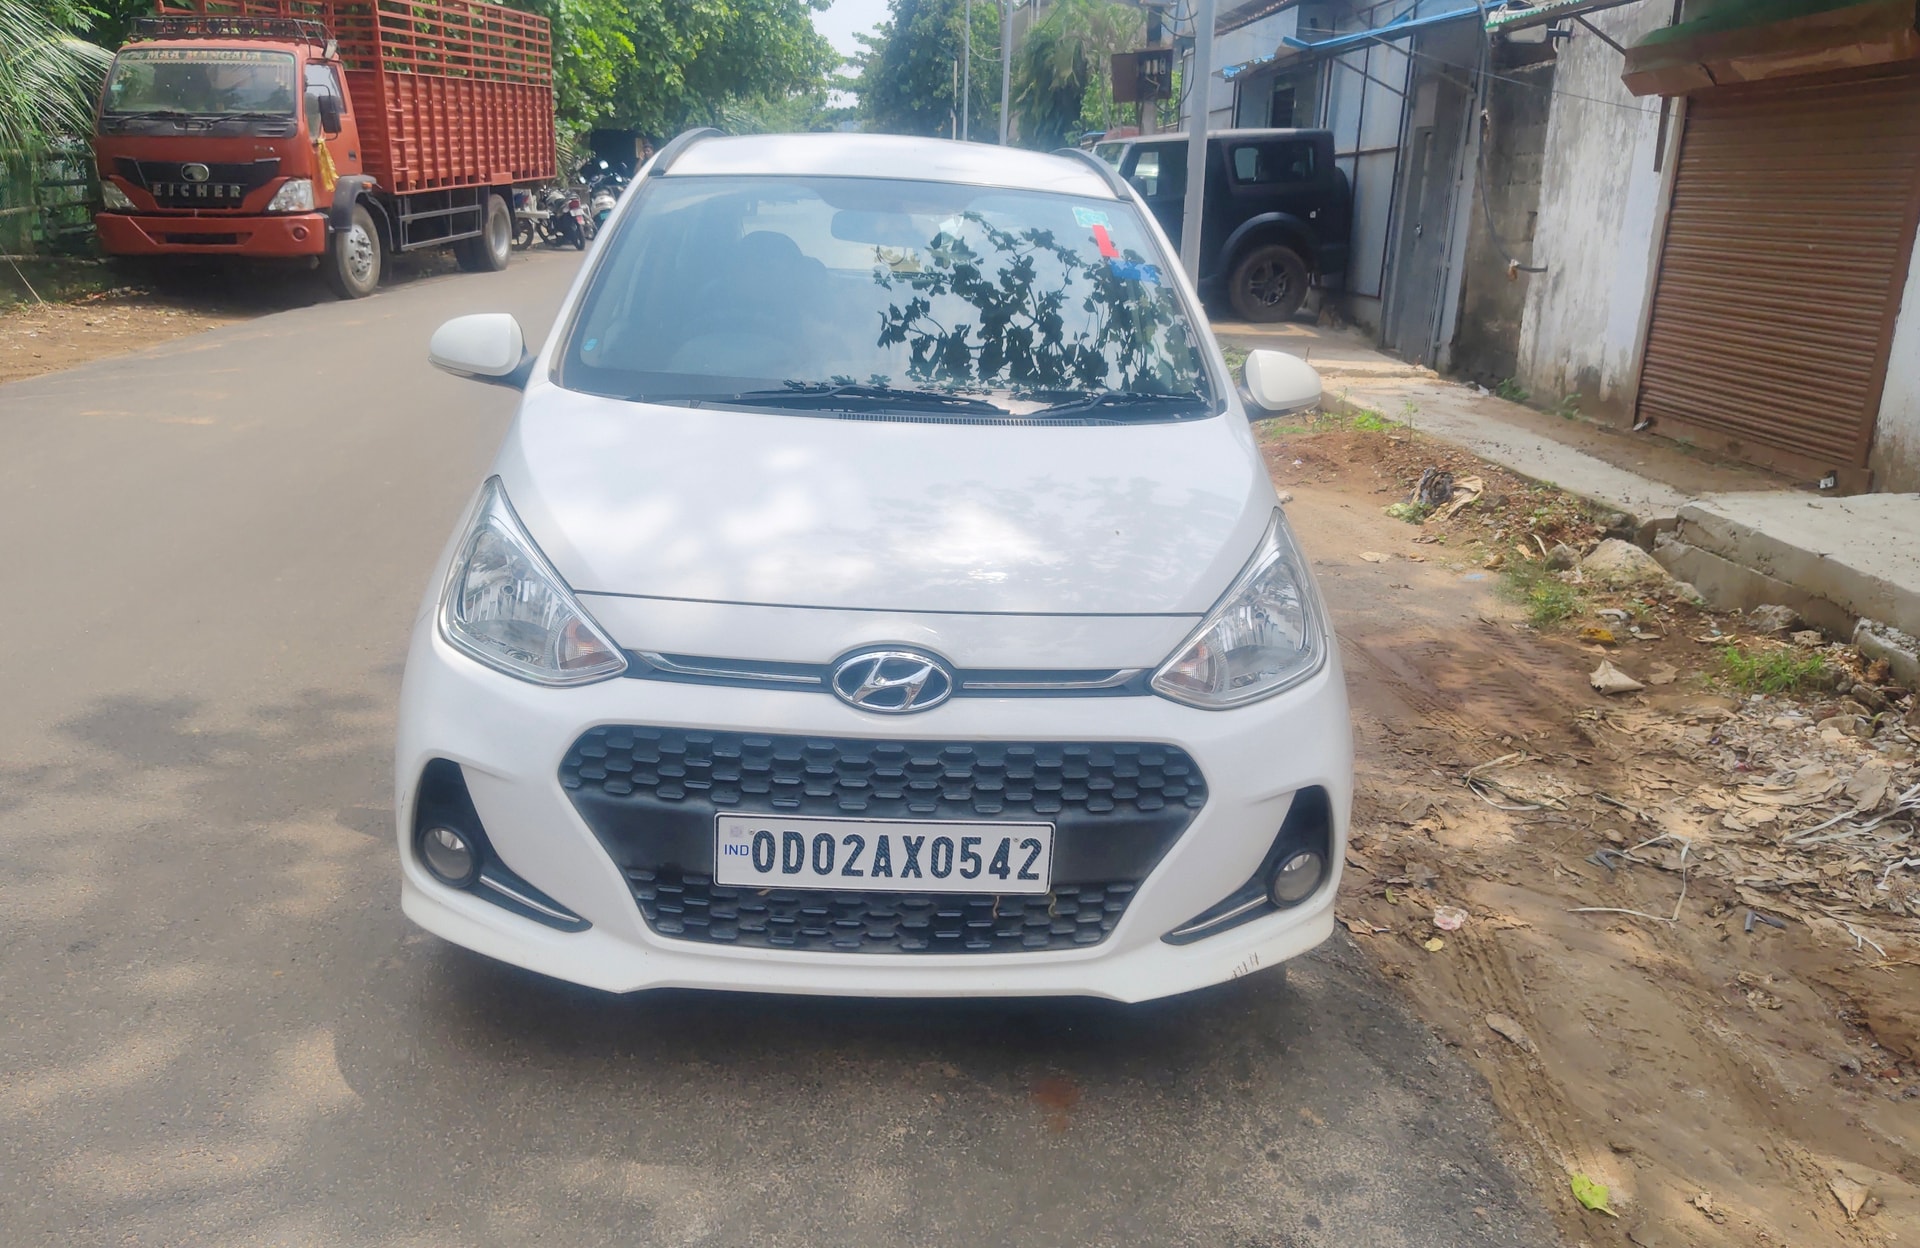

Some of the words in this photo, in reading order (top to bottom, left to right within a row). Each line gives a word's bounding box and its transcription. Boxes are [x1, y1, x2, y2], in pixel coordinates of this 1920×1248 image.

[147, 49, 180, 61] MAA
[185, 49, 262, 61] MANGALA
[152, 183, 241, 198] EICHER
[724, 843, 749, 856] IND
[751, 830, 1043, 880] OD02AX0542
